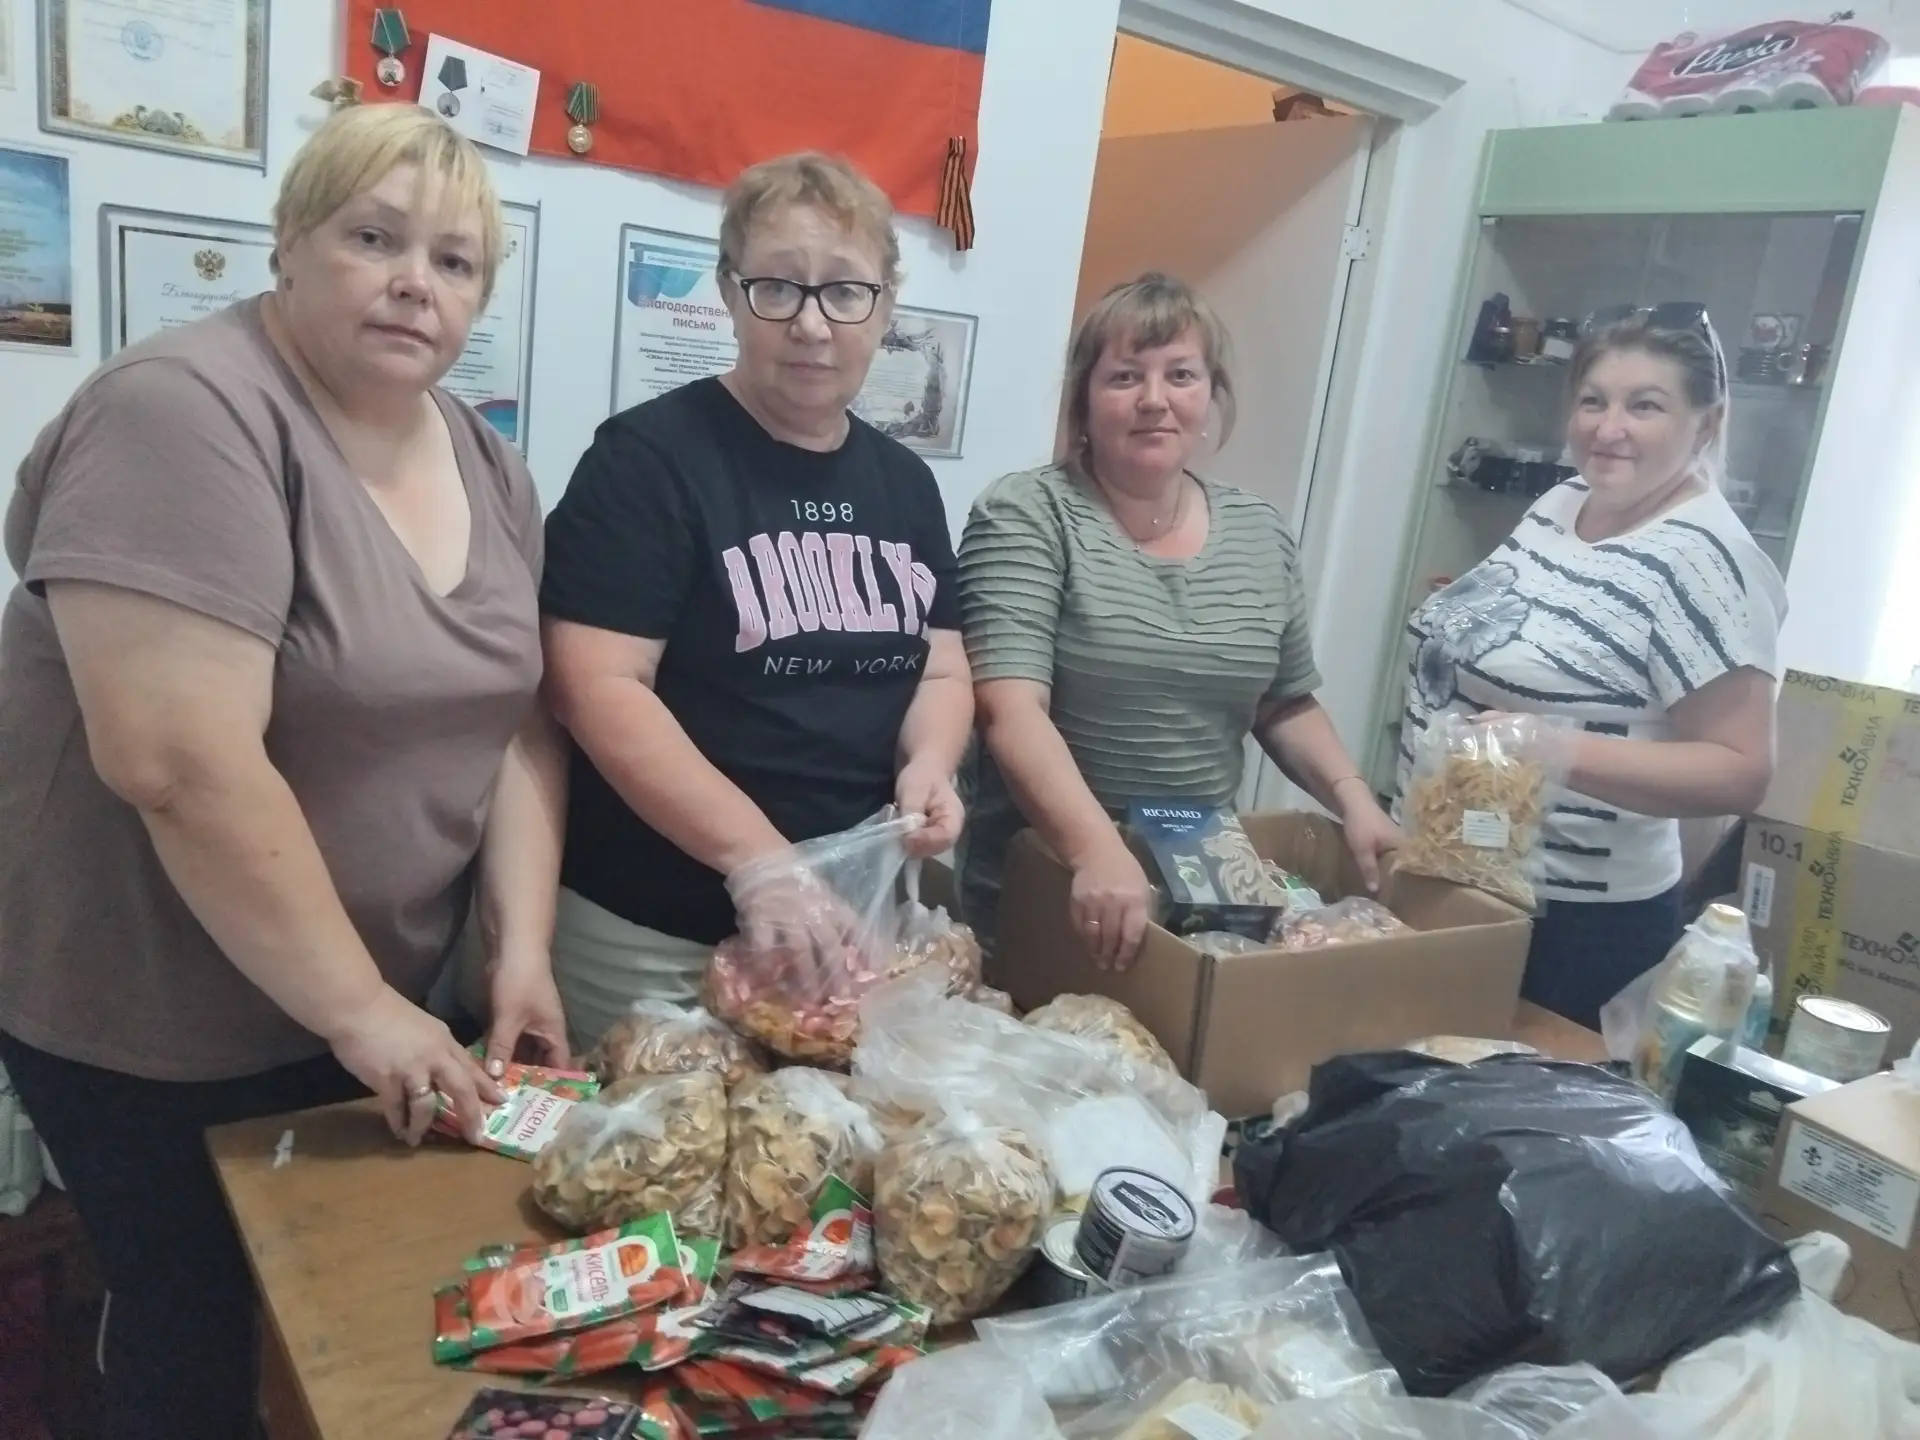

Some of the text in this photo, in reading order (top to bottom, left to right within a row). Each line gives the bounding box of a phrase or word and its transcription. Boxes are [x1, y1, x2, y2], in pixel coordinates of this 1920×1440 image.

[672, 317, 716, 331] письмо
[791, 500, 854, 522] 1898
[764, 653, 920, 675] NEW YORK
[1142, 808, 1202, 819] RICHARD
[1759, 830, 1803, 862] 10.1
